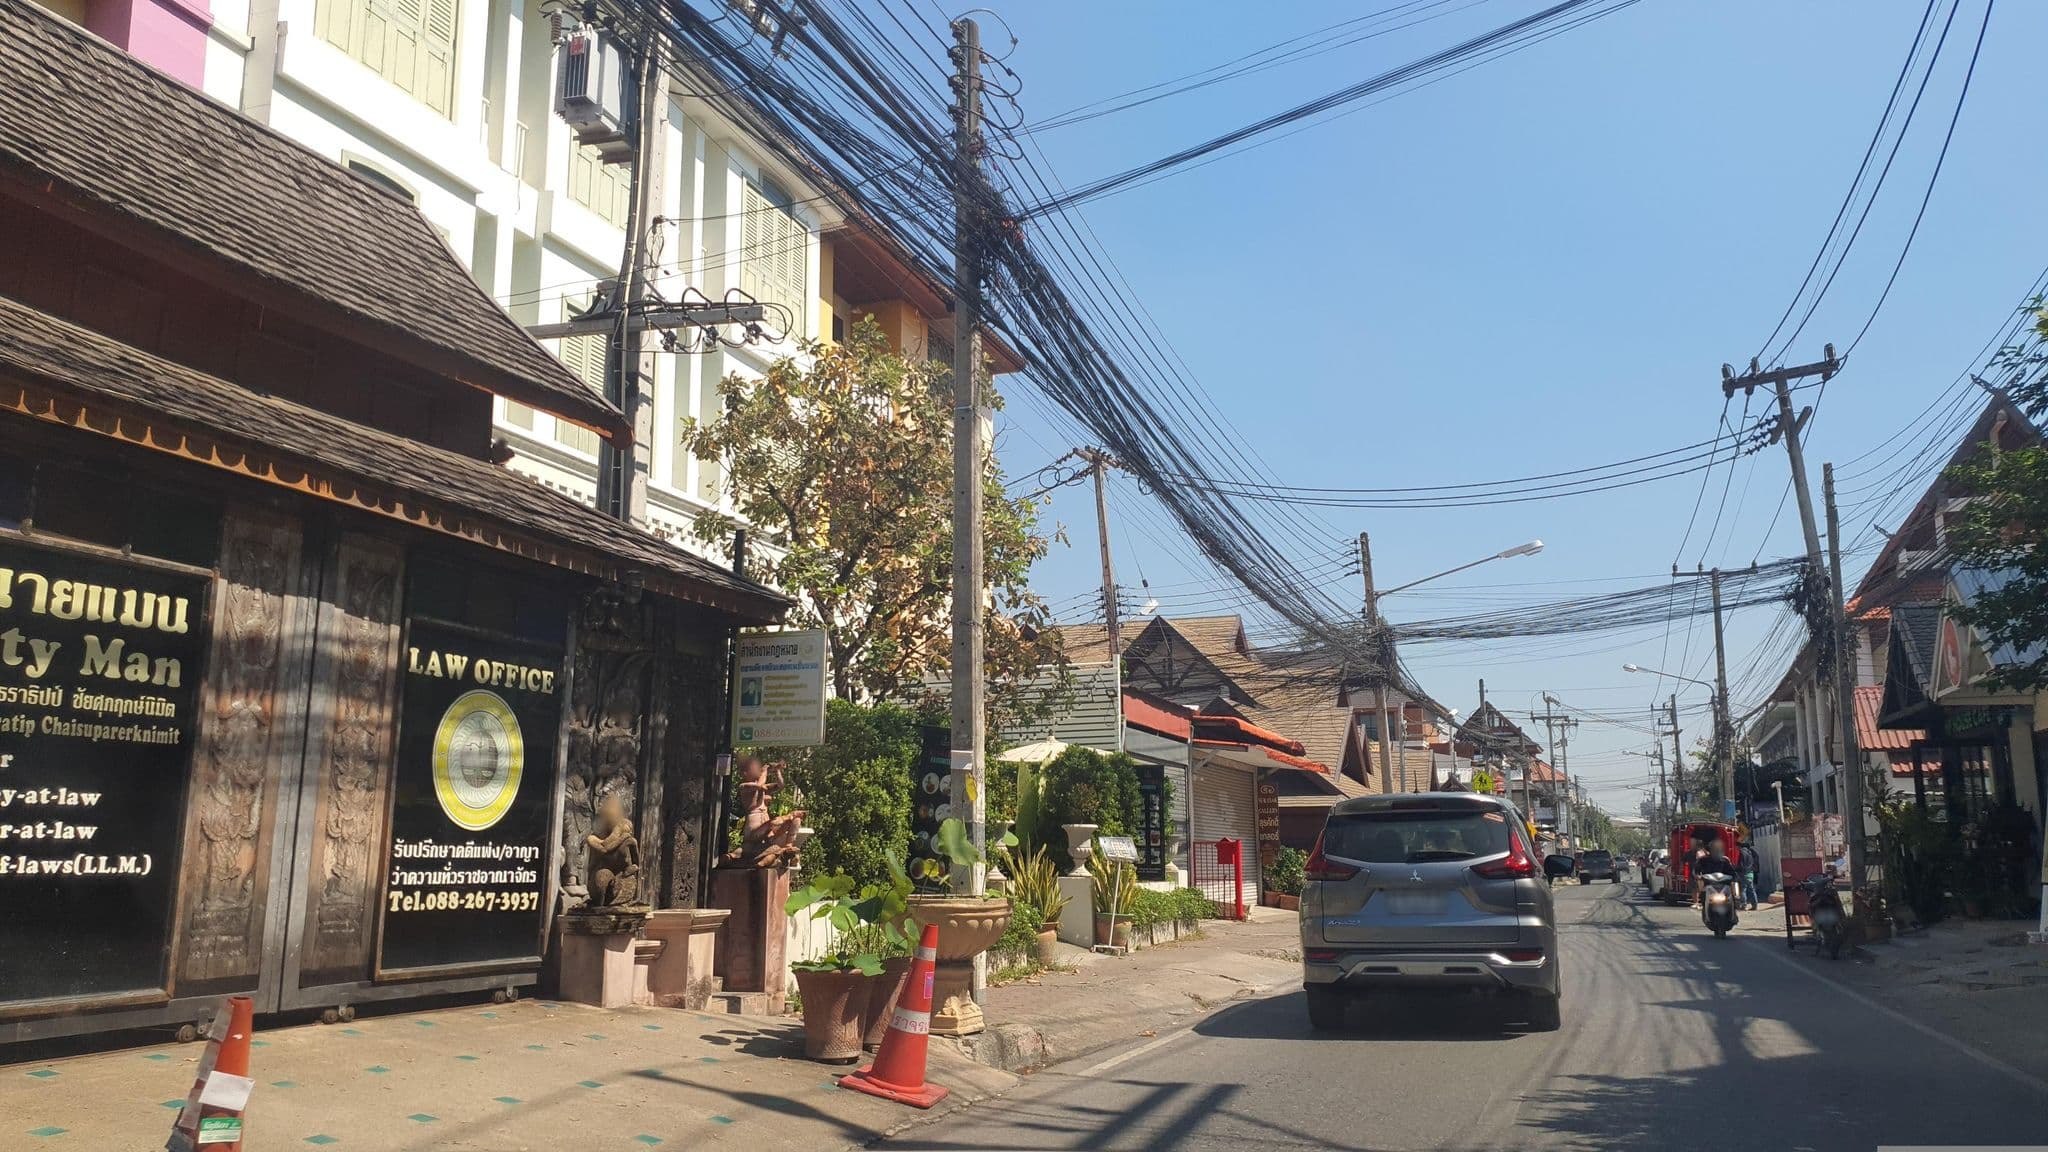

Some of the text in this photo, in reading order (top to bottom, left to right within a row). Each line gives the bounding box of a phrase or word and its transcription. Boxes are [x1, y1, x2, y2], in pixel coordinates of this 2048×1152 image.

[80, 634, 182, 688] Man
[408, 647, 554, 694] LAW OFFICE
[0, 714, 180, 745] atip Chaisuparerknimit
[0, 787, 102, 807] y-at-law
[0, 821, 98, 840] r-at-law
[394, 838, 539, 863] รับปรึกษาคดีแพ่ง/อาญา
[0, 854, 152, 875] f-laws(LL.M.)
[391, 861, 537, 886] ว่าความทั่วราชอาณาจักร
[389, 890, 539, 912] Tel.088-267-3937
